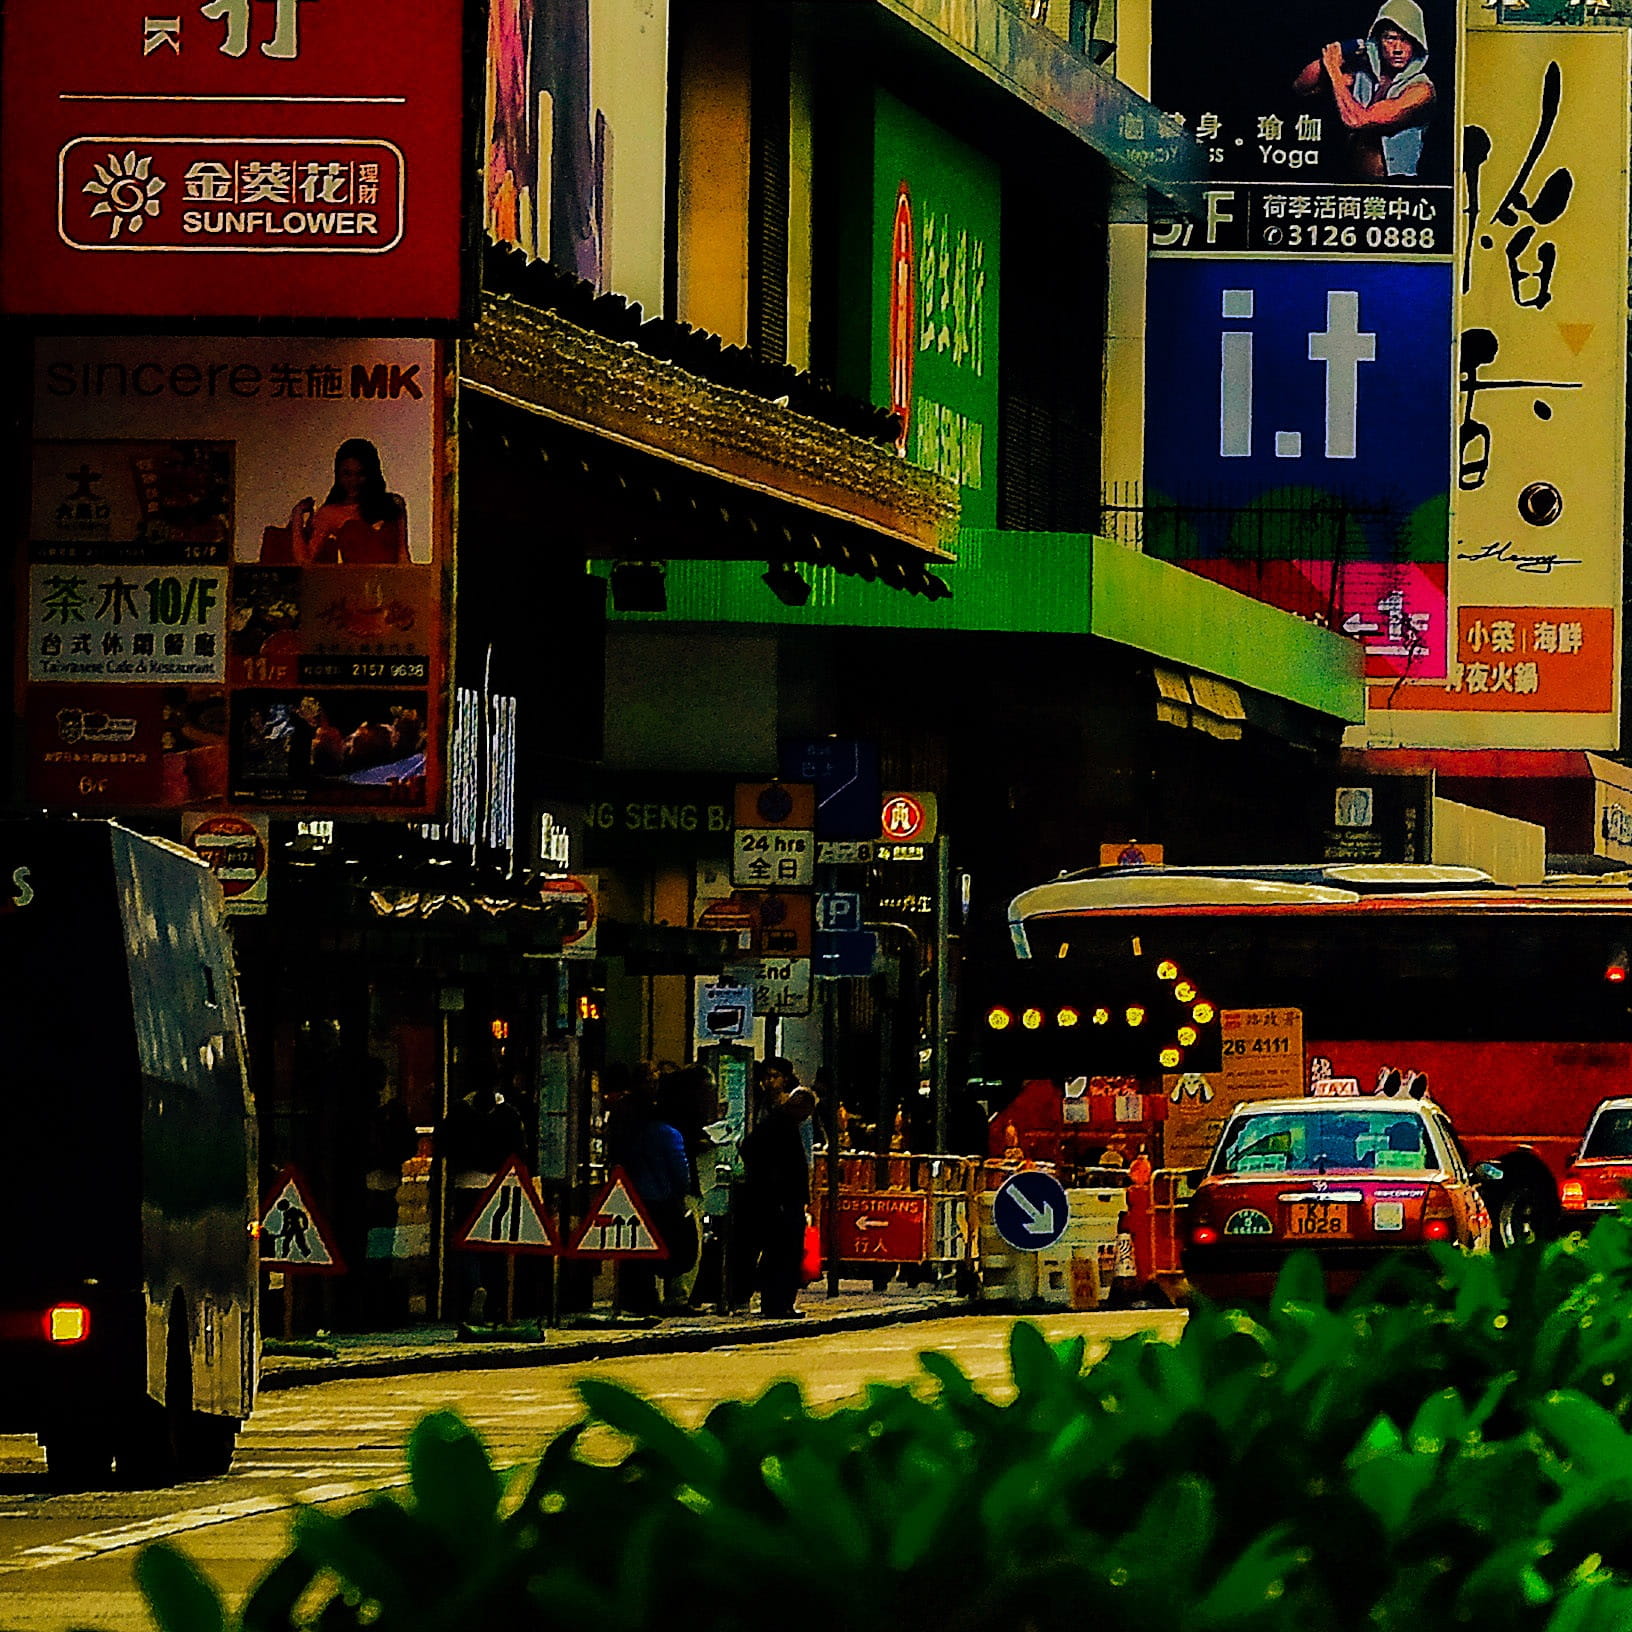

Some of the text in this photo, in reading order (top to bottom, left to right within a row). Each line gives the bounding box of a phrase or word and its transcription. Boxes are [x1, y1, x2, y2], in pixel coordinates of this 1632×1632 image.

[1256, 113, 1322, 143] 瑜伽
[1258, 145, 1319, 169] Yoga
[182, 160, 380, 205] 金葵花 理財
[1262, 194, 1437, 220] 荷李活商業中心
[181, 210, 379, 236] SUNFLOWER
[1288, 224, 1436, 249] 3126 0888
[46, 362, 422, 400] sincere 先施 MK
[1219, 289, 1377, 459] i.t
[143, 575, 219, 626] 10/F
[1467, 620, 1583, 655] 小菜 海鮮
[625, 803, 698, 832] SENG
[741, 835, 806, 852] 24 hrs
[748, 858, 798, 880] 全日
[828, 898, 850, 925] P
[1252, 1036, 1290, 1054] 4111
[1317, 1079, 1356, 1095] TAXI
[1297, 1217, 1342, 1233] 1028
